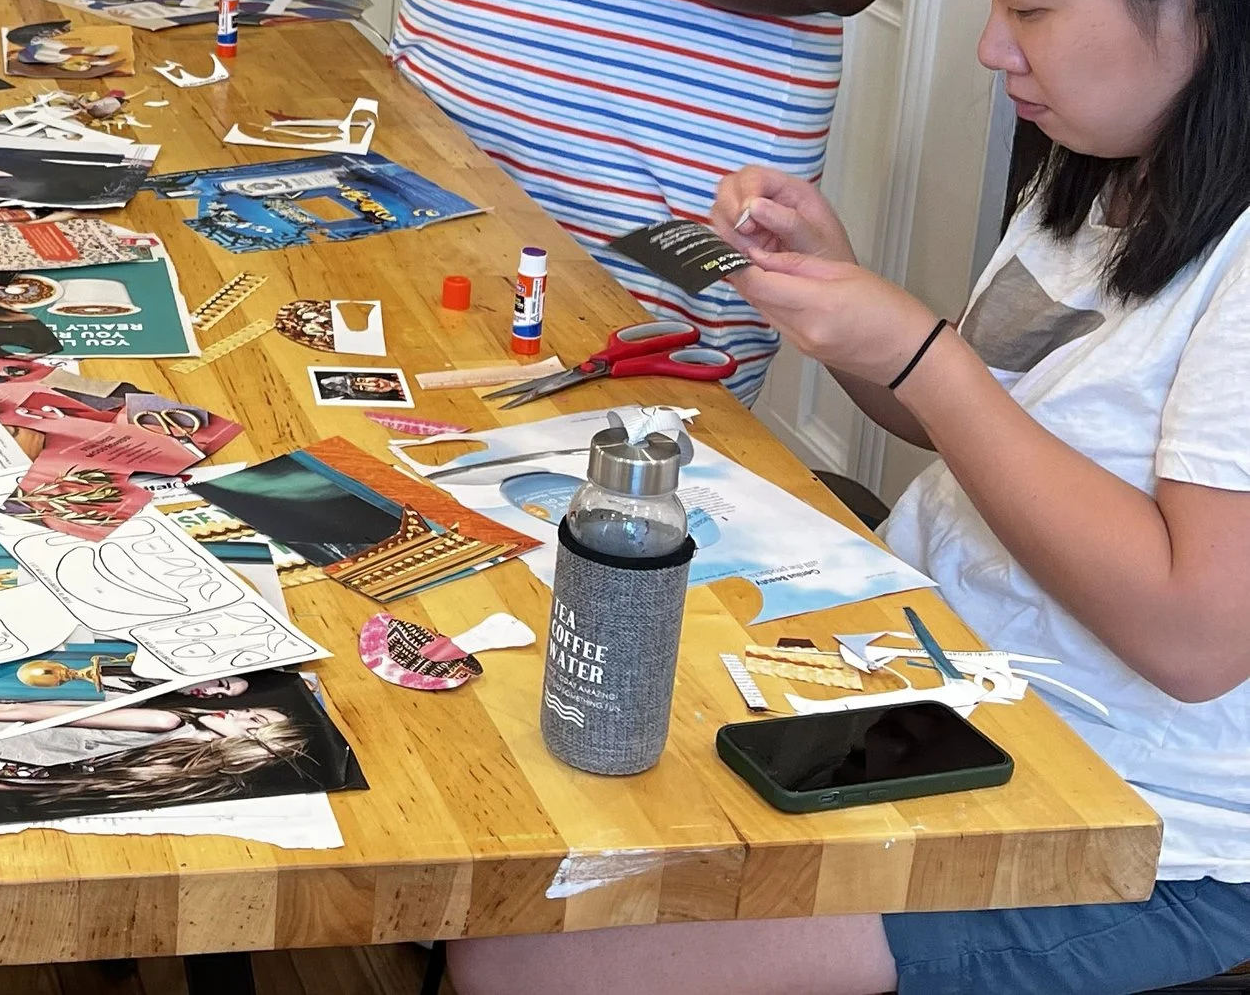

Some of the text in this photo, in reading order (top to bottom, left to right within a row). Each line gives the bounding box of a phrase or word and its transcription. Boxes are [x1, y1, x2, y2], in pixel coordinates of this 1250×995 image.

[65, 323, 144, 331] REALLY
[80, 331, 125, 339] YOU
[85, 339, 131, 347] YOU
[553, 596, 576, 631] TEA
[551, 618, 609, 664] COFFEE
[549, 638, 604, 685] WATER
